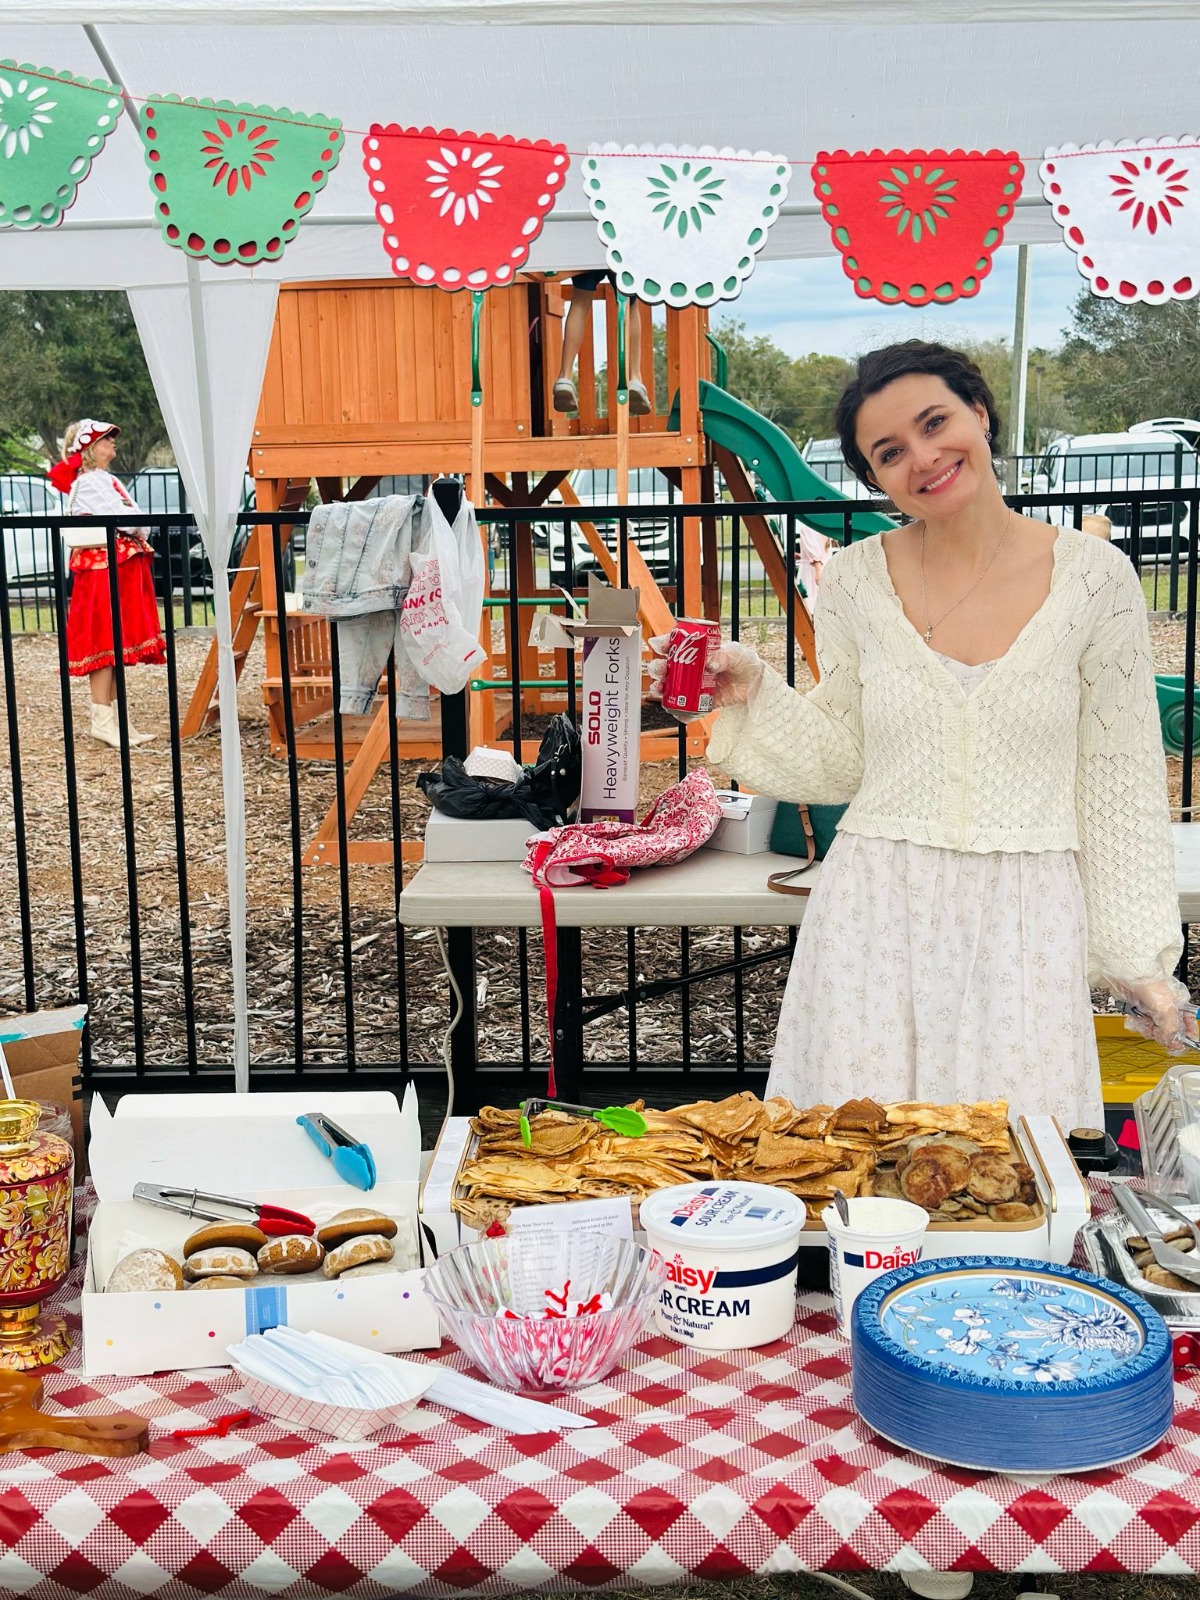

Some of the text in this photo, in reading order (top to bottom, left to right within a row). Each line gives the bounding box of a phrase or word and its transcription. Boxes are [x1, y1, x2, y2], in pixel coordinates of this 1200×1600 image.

[588, 691, 601, 746] SOLO
[603, 637, 621, 799] Heavyweight Forks
[672, 1194, 715, 1217] Daisy
[695, 1190, 739, 1227] SOUR CREAM
[675, 1295, 750, 1318] CREAM
